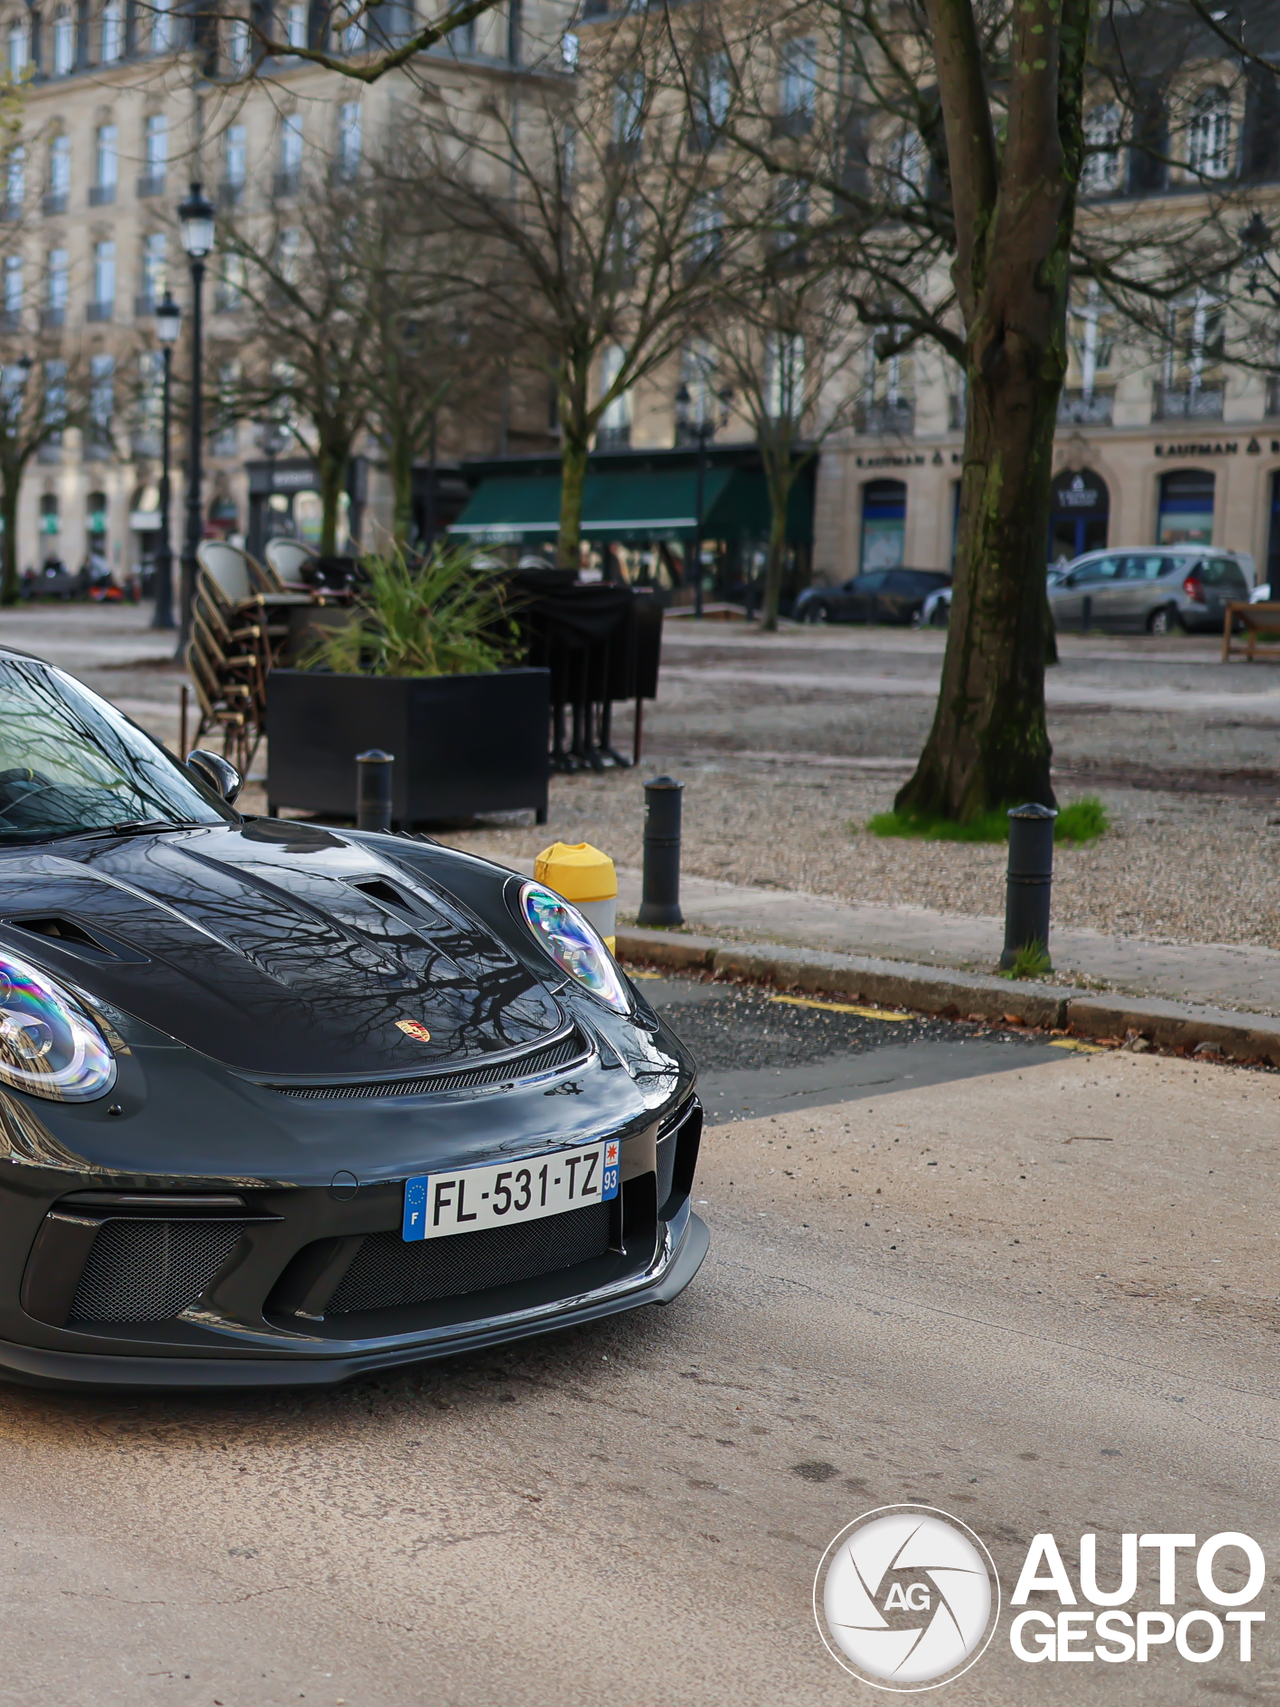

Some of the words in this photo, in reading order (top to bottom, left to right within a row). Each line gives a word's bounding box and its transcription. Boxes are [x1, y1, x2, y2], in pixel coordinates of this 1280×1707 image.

[433, 1151, 599, 1227] FL-531-TZ
[604, 1169, 617, 1190] 93
[410, 1211, 419, 1226] F
